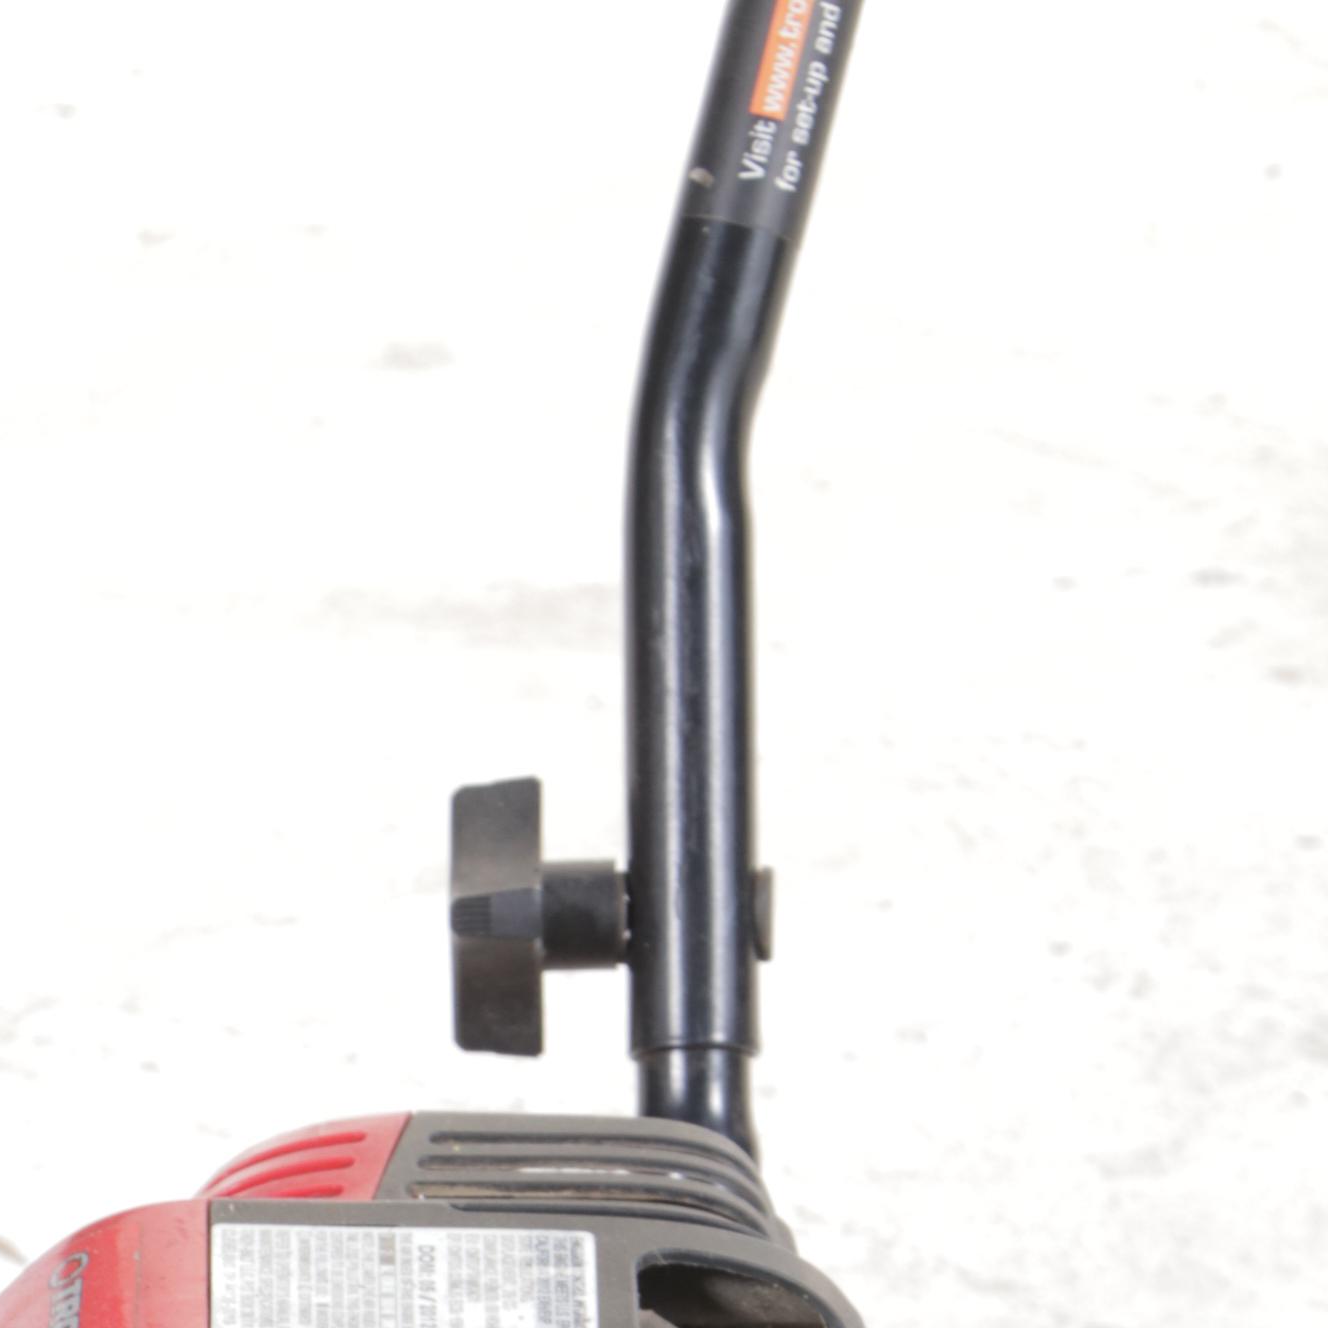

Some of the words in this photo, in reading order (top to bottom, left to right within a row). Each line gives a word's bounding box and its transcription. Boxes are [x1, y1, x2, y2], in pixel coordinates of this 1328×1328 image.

[738, 120, 776, 180] Visit
[774, 150, 802, 192] for
[792, 61, 829, 146] set-up
[815, 2, 841, 54] and
